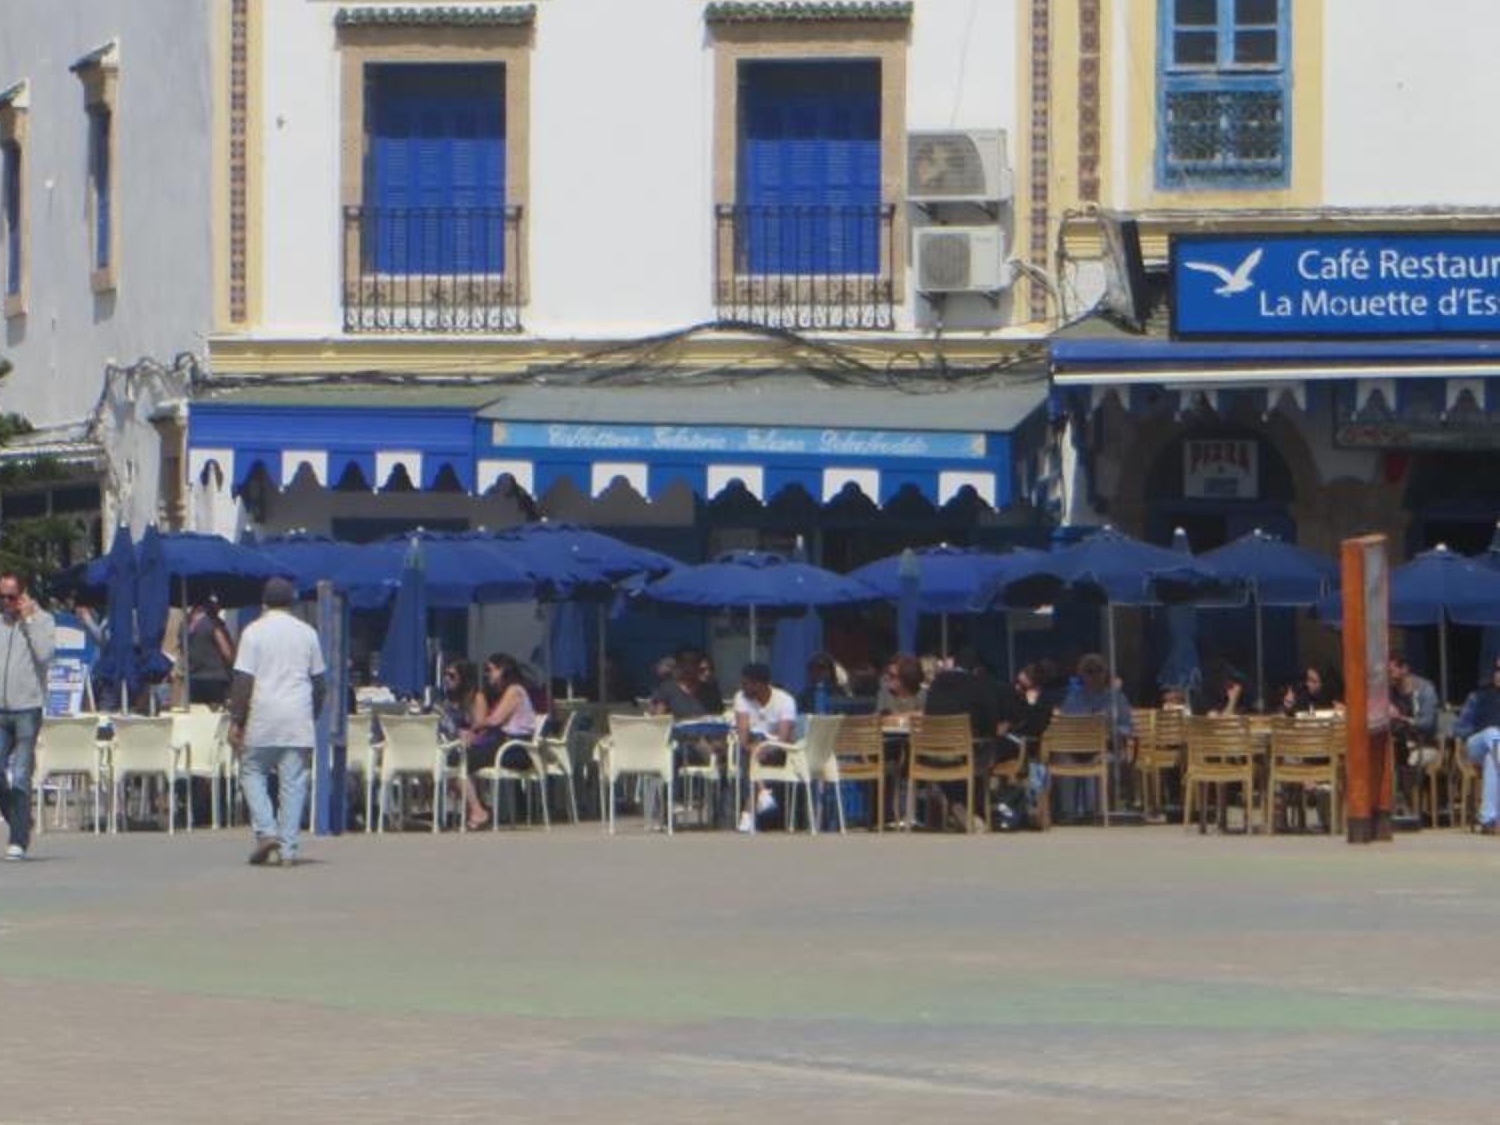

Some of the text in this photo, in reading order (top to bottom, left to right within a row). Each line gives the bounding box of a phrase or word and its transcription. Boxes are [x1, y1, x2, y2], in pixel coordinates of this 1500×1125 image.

[1298, 249, 1370, 279] Café
[1260, 287, 1500, 316] La Mouette d'Es
